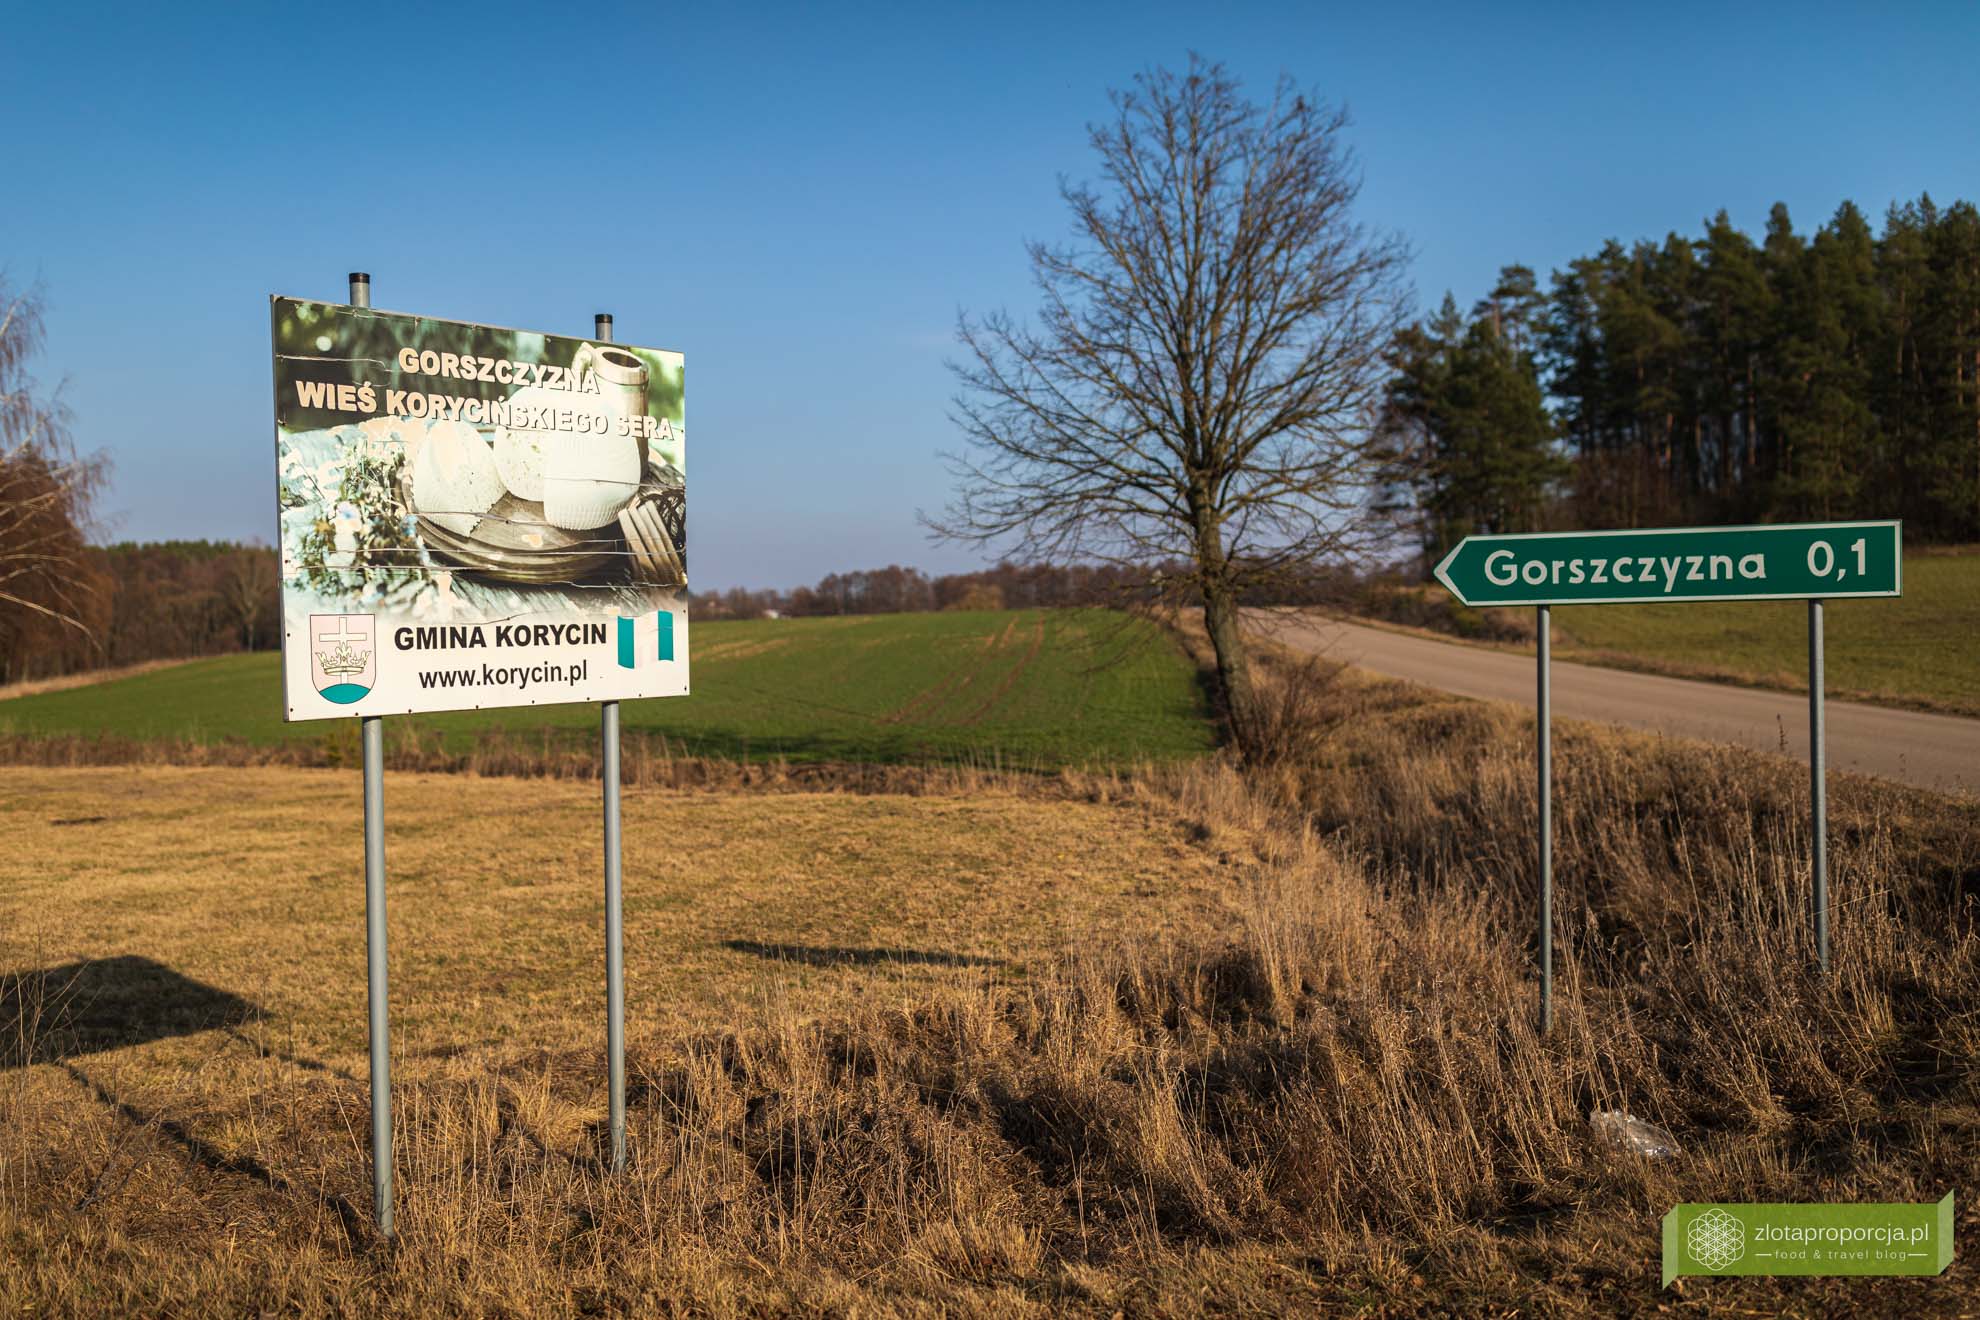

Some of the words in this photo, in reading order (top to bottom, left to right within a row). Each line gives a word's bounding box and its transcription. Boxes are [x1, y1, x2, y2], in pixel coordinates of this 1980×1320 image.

[399, 347, 600, 395] GORSZCZYZNA
[296, 380, 376, 413] WIEŚ
[386, 389, 609, 435] KORYCIŃSKIEGO
[617, 415, 675, 441] SERA
[1484, 549, 1767, 593] Gorszczyzna
[1807, 538, 1867, 582] 0,1
[394, 625, 487, 651] GMINA
[496, 623, 607, 648] KORYCIN
[418, 659, 588, 690] www.korycin.pl
